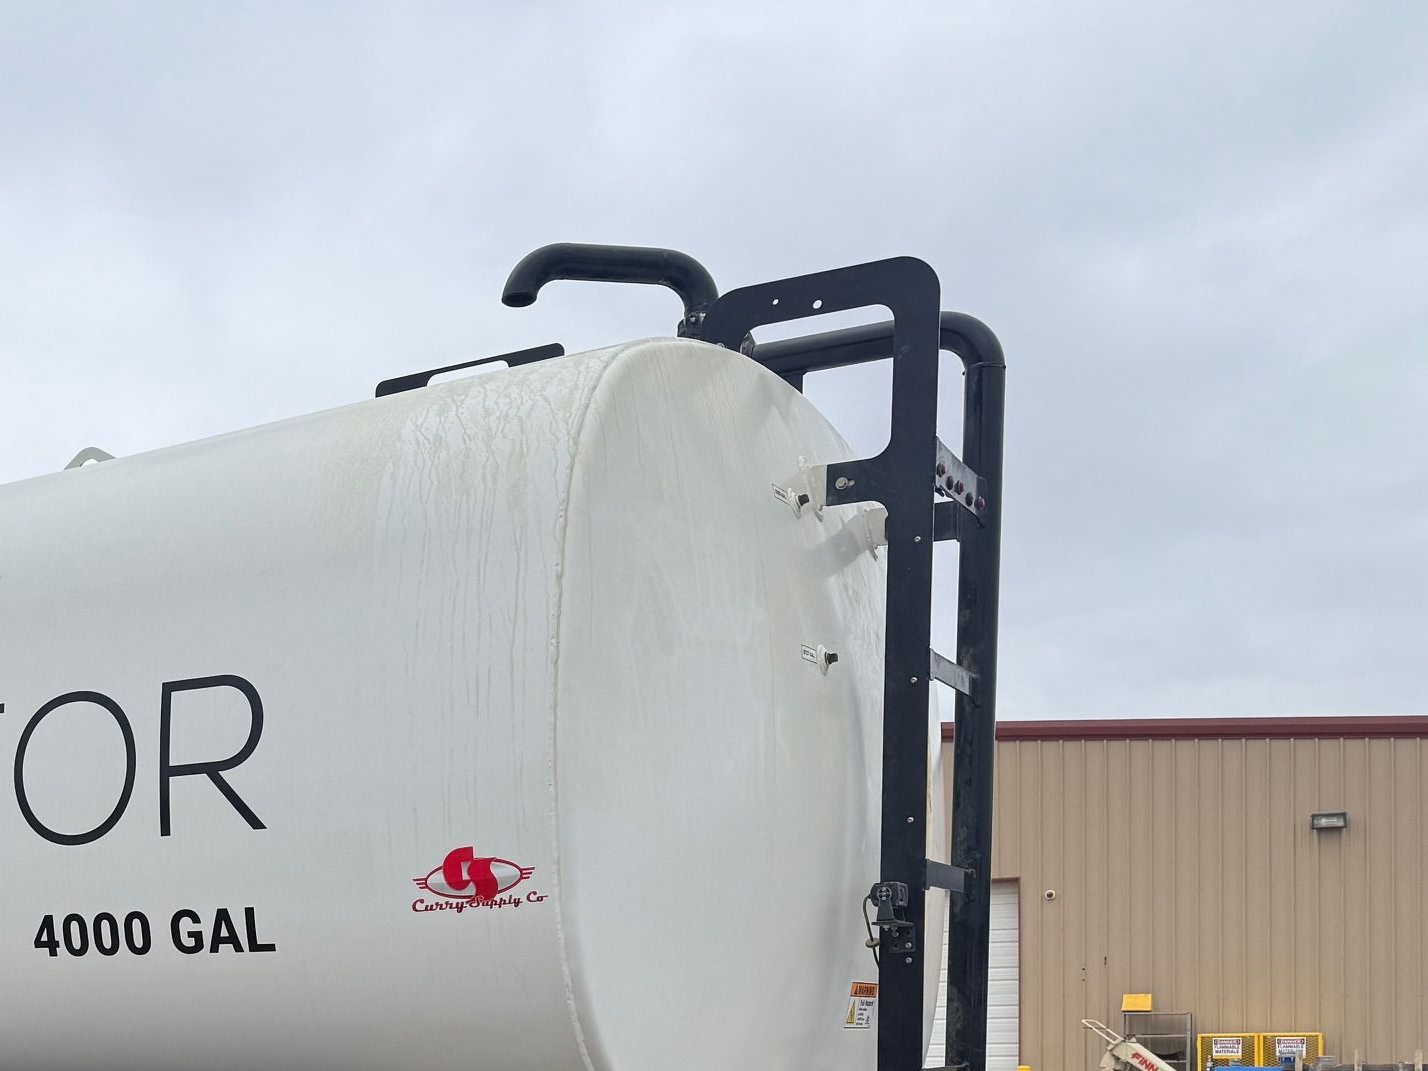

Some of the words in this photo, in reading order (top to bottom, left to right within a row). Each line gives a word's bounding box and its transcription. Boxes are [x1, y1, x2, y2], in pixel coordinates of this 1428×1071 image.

[411, 898, 467, 913] Curry
[466, 894, 523, 910] Supply
[526, 890, 549, 903] Co
[33, 912, 153, 958] 4000
[171, 906, 277, 956] GAL
